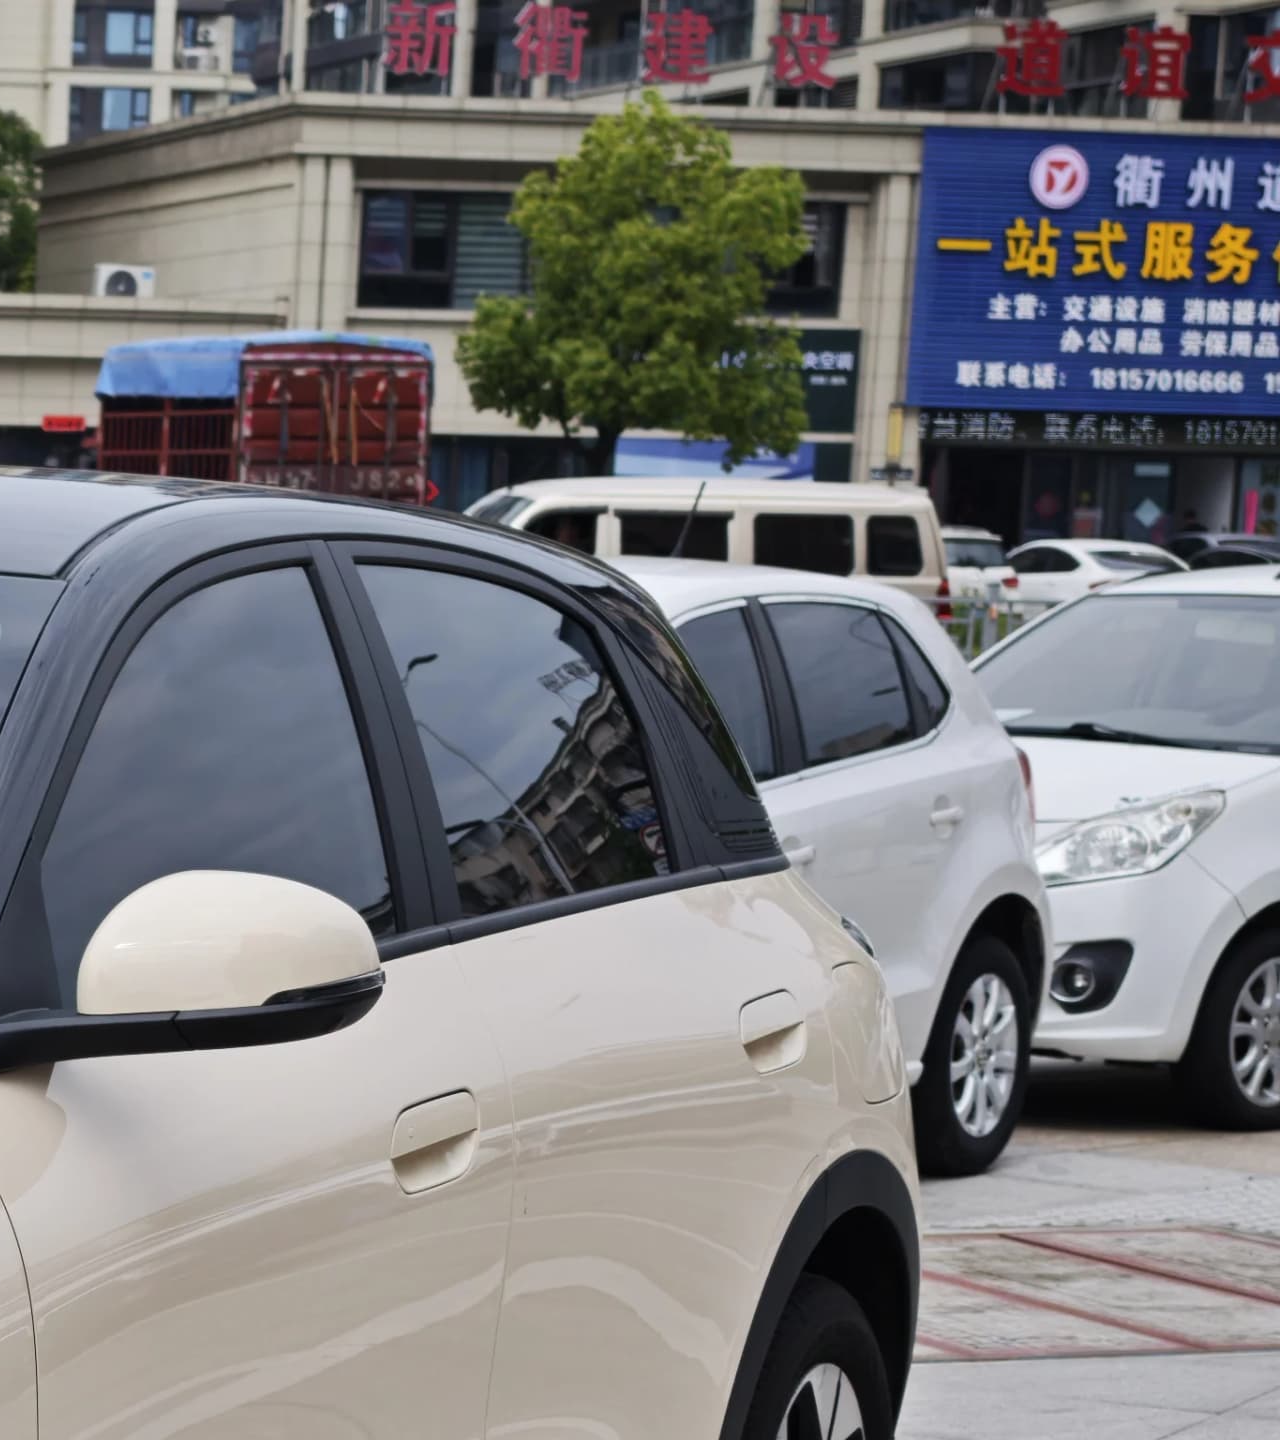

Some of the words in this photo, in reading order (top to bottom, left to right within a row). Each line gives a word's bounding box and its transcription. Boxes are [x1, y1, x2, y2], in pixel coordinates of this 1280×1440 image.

[382, 0, 838, 90] 新衢建设
[937, 217, 1280, 284] 一站式服务
[1062, 295, 1165, 323] 交通设施
[1060, 326, 1163, 355] 办公用品
[1090, 367, 1244, 394] 18157016666
